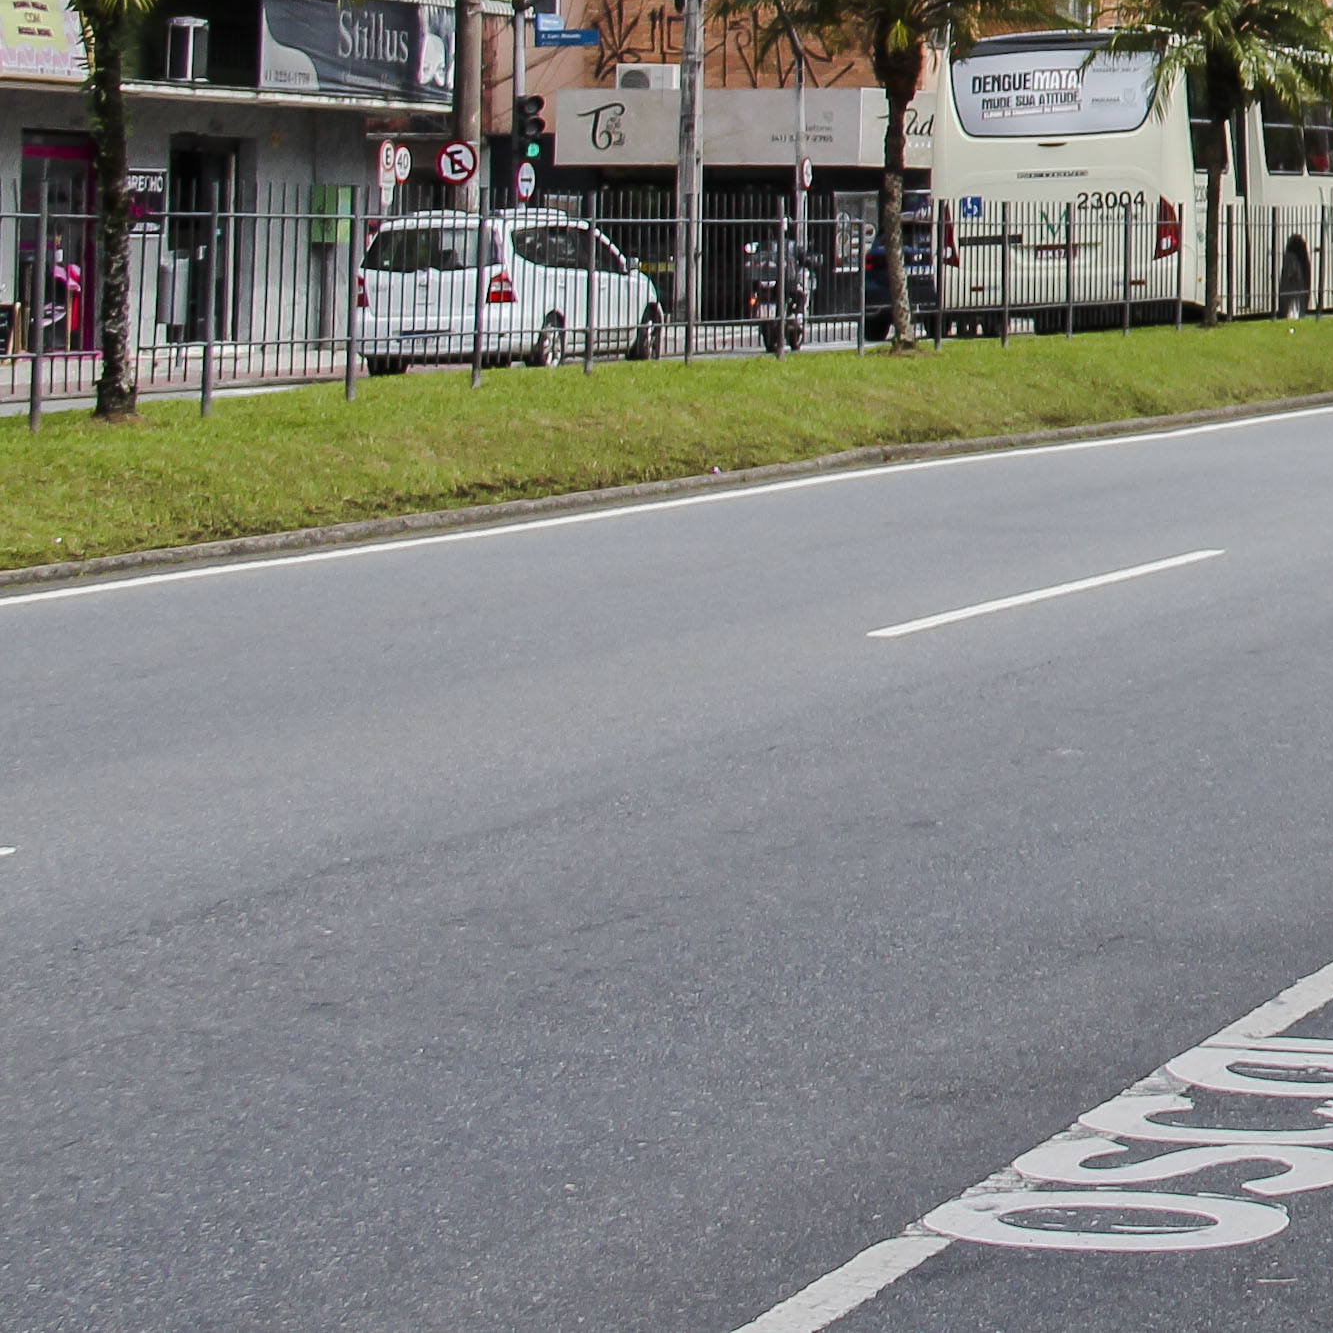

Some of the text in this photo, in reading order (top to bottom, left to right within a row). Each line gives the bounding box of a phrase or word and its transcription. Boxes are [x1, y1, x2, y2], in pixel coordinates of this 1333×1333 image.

[338, 10, 408, 63] Stillus
[972, 73, 1032, 94] DENGUE
[982, 97, 1011, 110] MUDE
[1016, 94, 1036, 108] SUA
[385, 148, 409, 169] E 40
[446, 148, 467, 175] E
[1077, 191, 1144, 209] 23004
